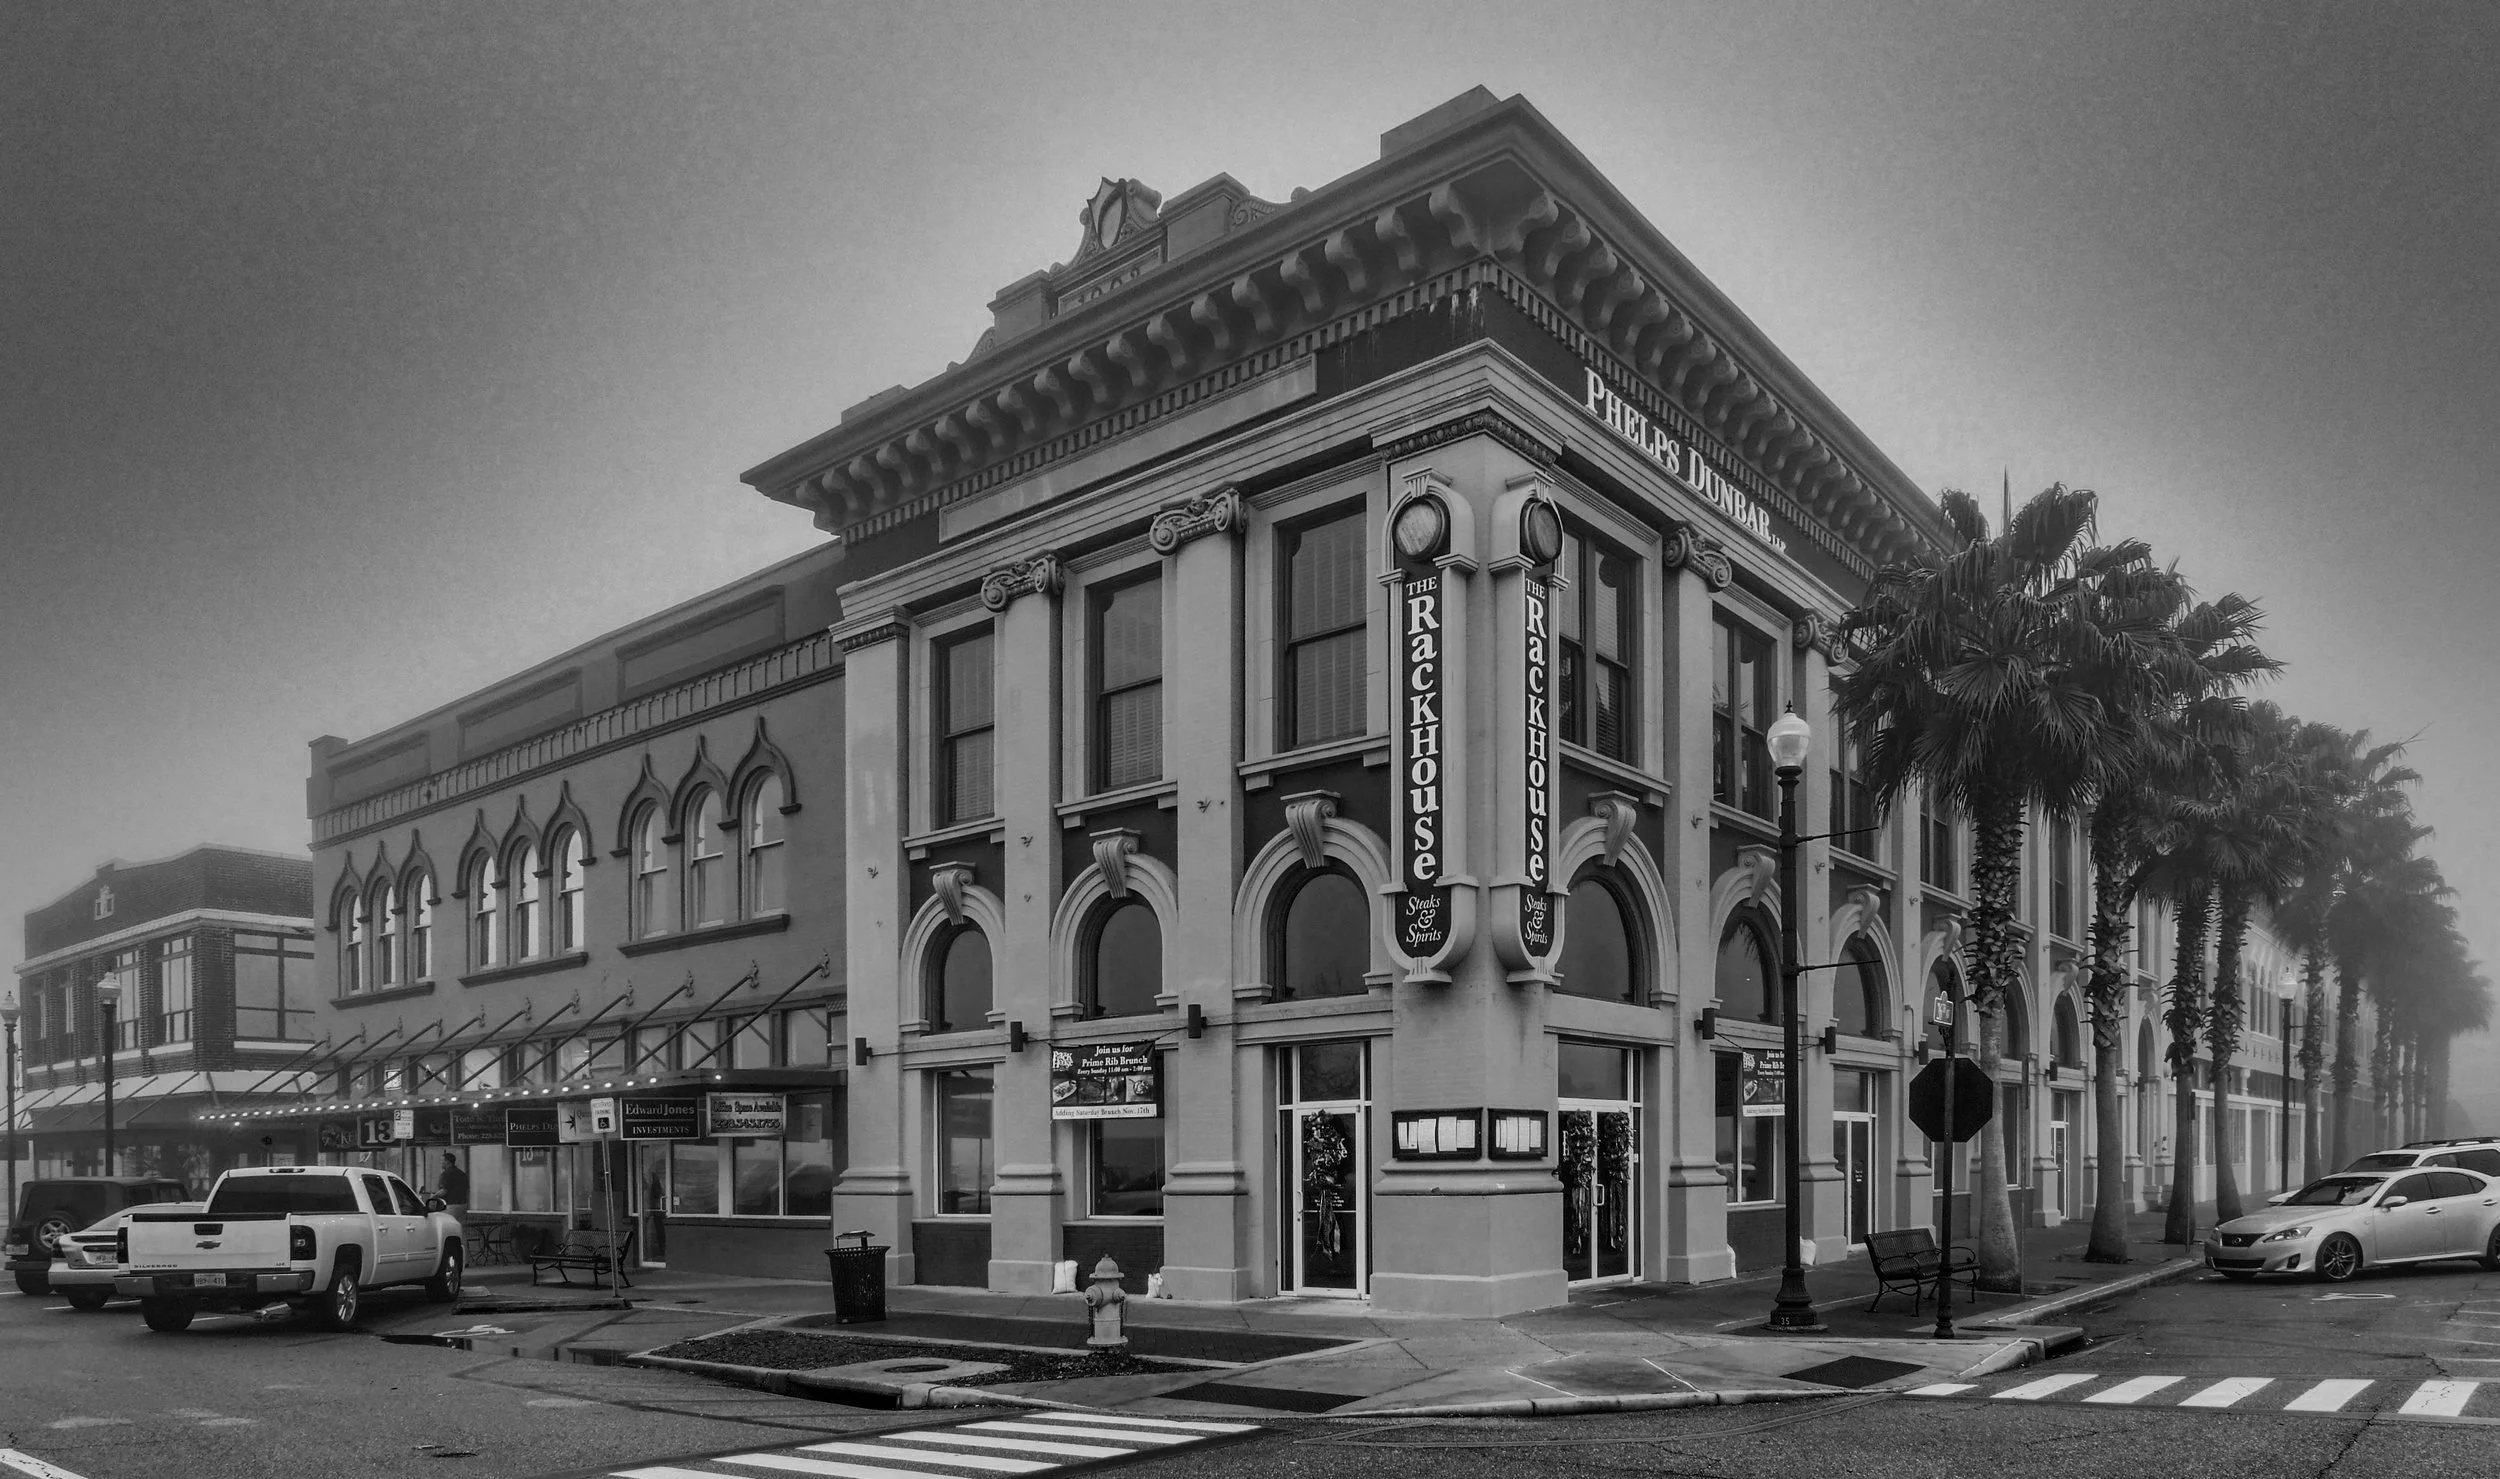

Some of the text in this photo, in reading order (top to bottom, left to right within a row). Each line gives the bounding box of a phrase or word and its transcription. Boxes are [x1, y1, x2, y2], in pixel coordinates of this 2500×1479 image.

[1584, 366, 1679, 473] PHELPS
[1686, 446, 1771, 543] DUNBAR
[1406, 576, 1437, 596] THE
[1525, 578, 1545, 600] THE
[1406, 896, 1440, 916] Steaks
[1525, 893, 1547, 915] Steaks
[1417, 910, 1434, 929] &
[1532, 910, 1544, 930] &
[1406, 924, 1441, 946] Spirits
[1525, 921, 1547, 945] Spirits
[1094, 1045, 1110, 1057] Join
[1121, 1045, 1134, 1053] for
[1082, 1056, 1148, 1067] Prime Rib Brunch
[626, 1103, 695, 1116] Edward Jones
[364, 1121, 395, 1144] 13
[632, 1126, 690, 1134] INVESTMENTS
[1781, 1317, 1790, 1325] 35
